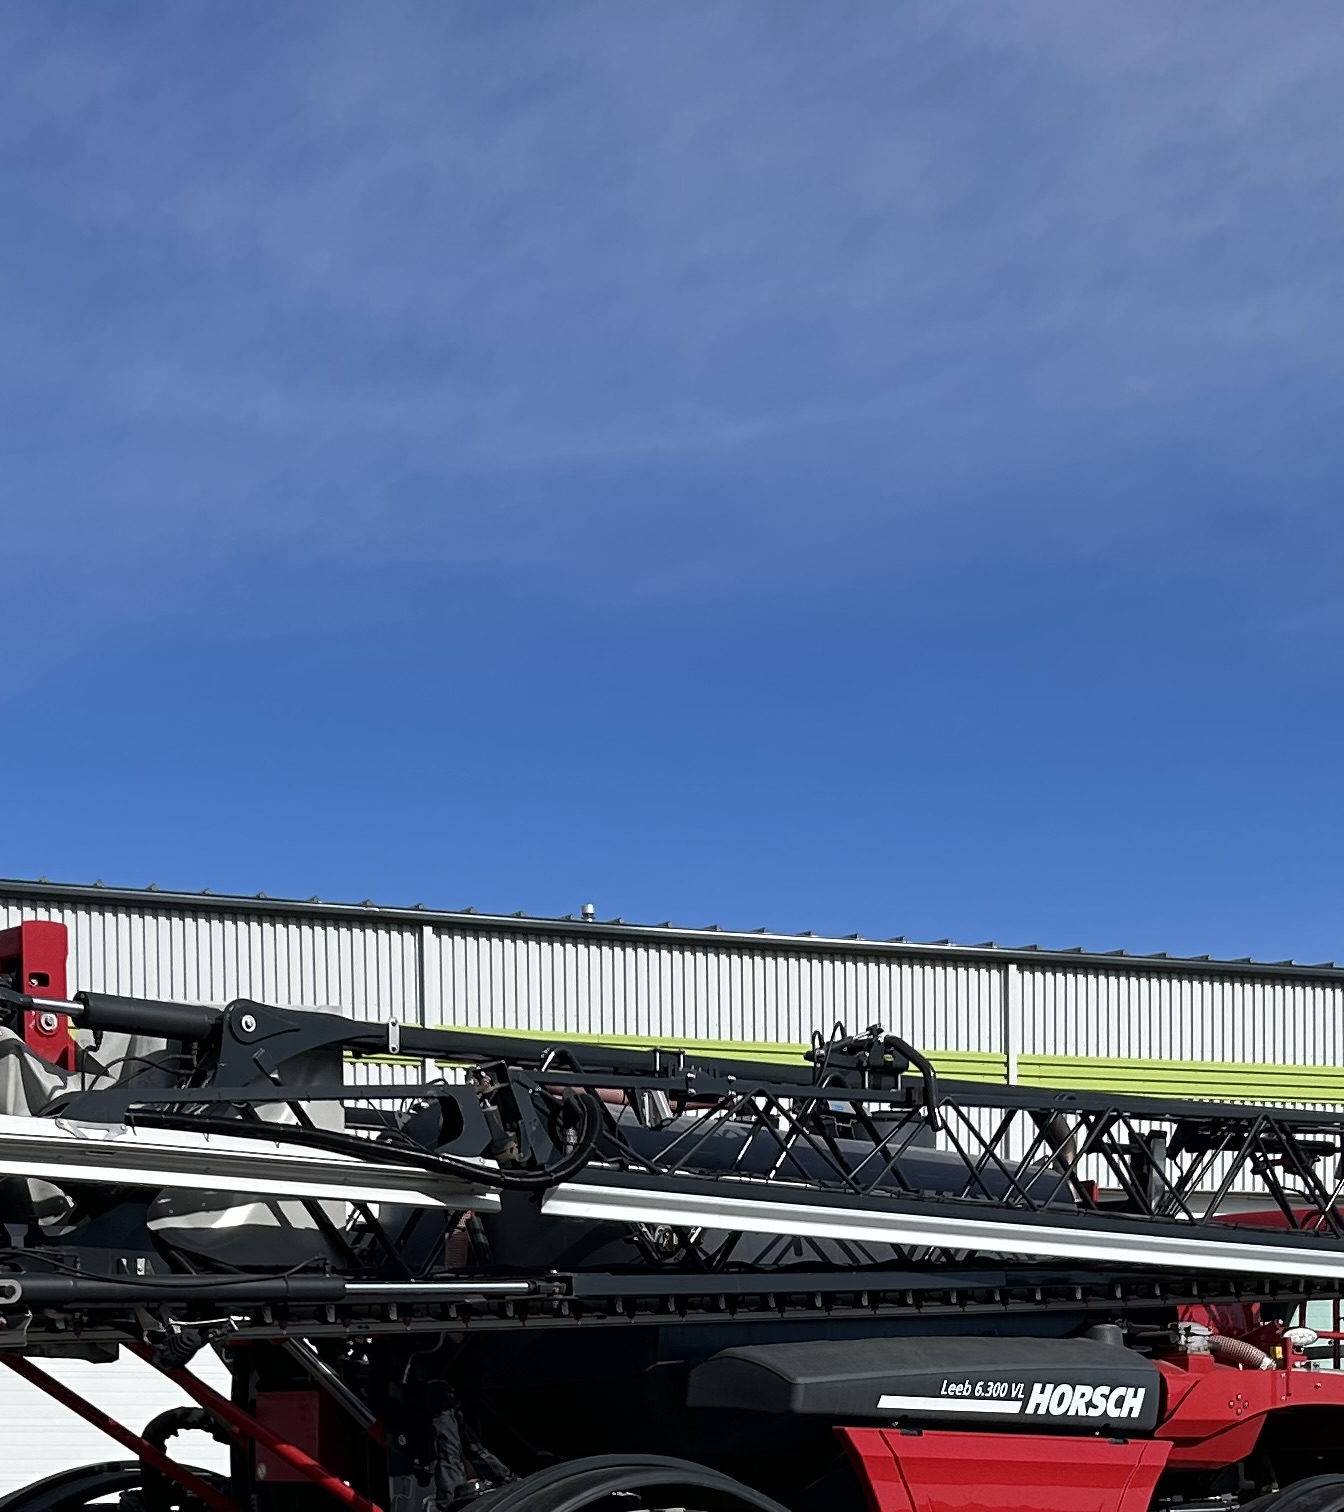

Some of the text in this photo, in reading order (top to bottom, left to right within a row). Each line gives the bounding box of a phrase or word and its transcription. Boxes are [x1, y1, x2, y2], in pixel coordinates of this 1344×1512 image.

[941, 1380, 1025, 1398] Leeb 6.300 VL
[1024, 1383, 1146, 1418] HORSCH
